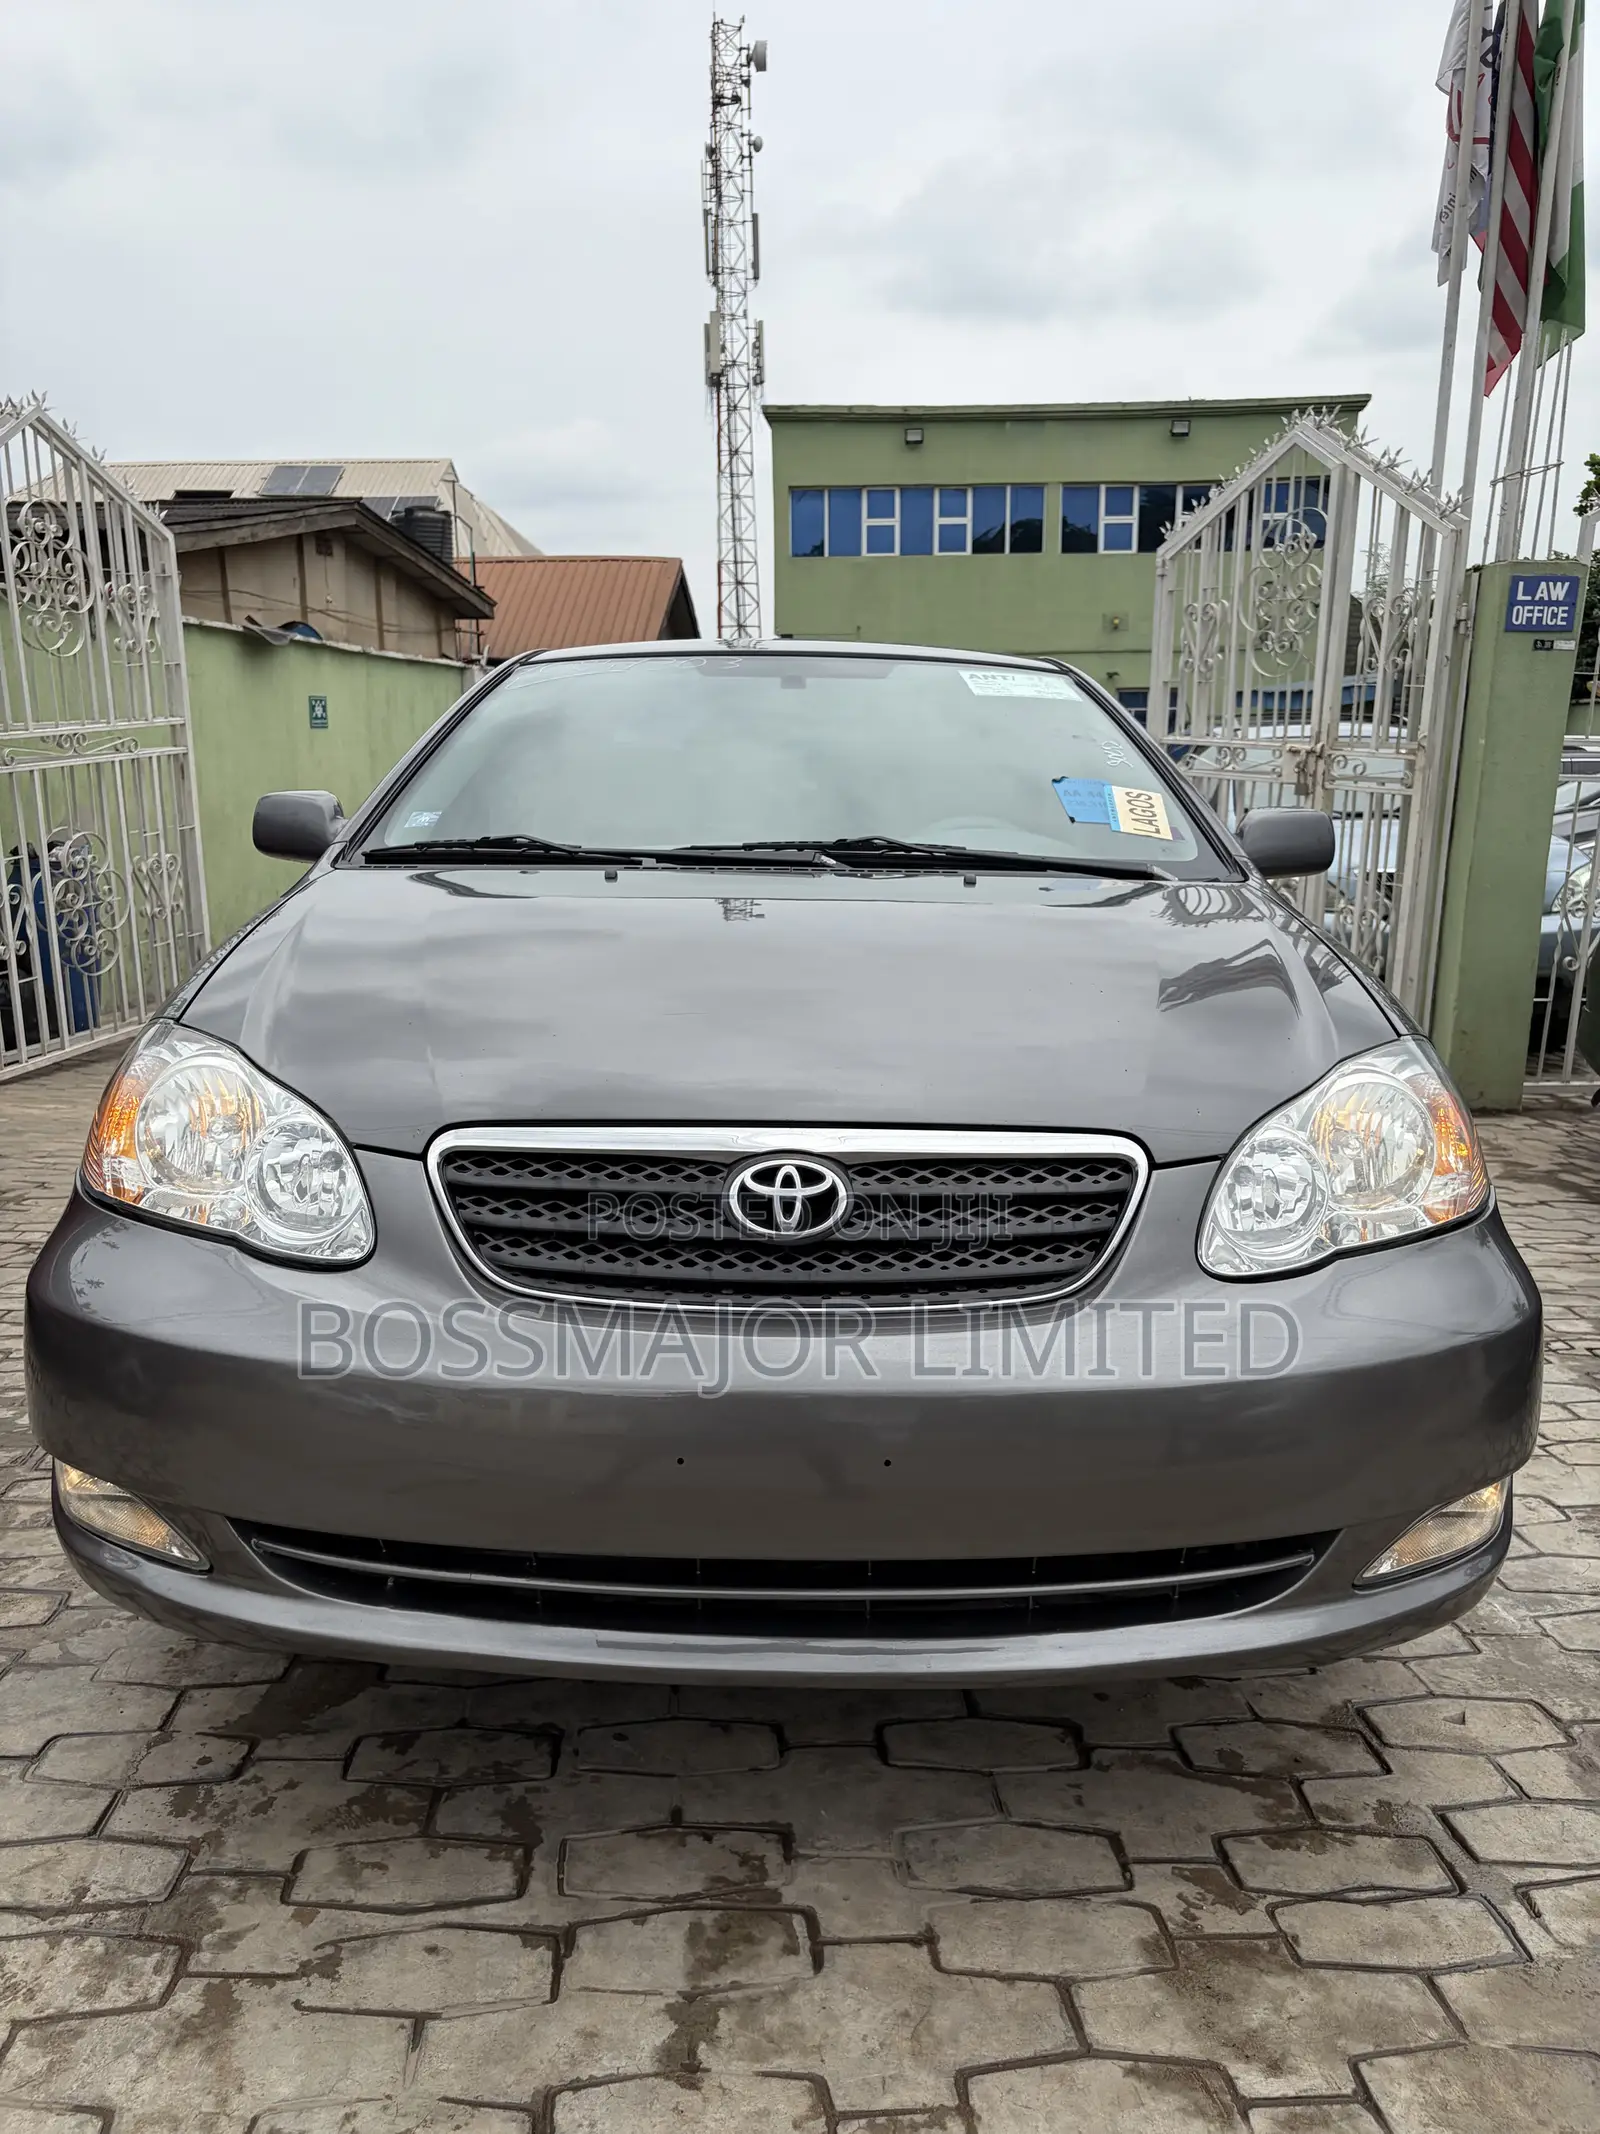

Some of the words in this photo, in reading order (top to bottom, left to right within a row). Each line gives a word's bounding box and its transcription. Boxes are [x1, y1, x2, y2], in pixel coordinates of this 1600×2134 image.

[1516, 581, 1570, 600] LAW
[1511, 605, 1569, 625] OFFICE
[1125, 791, 1161, 835] LAGOS
